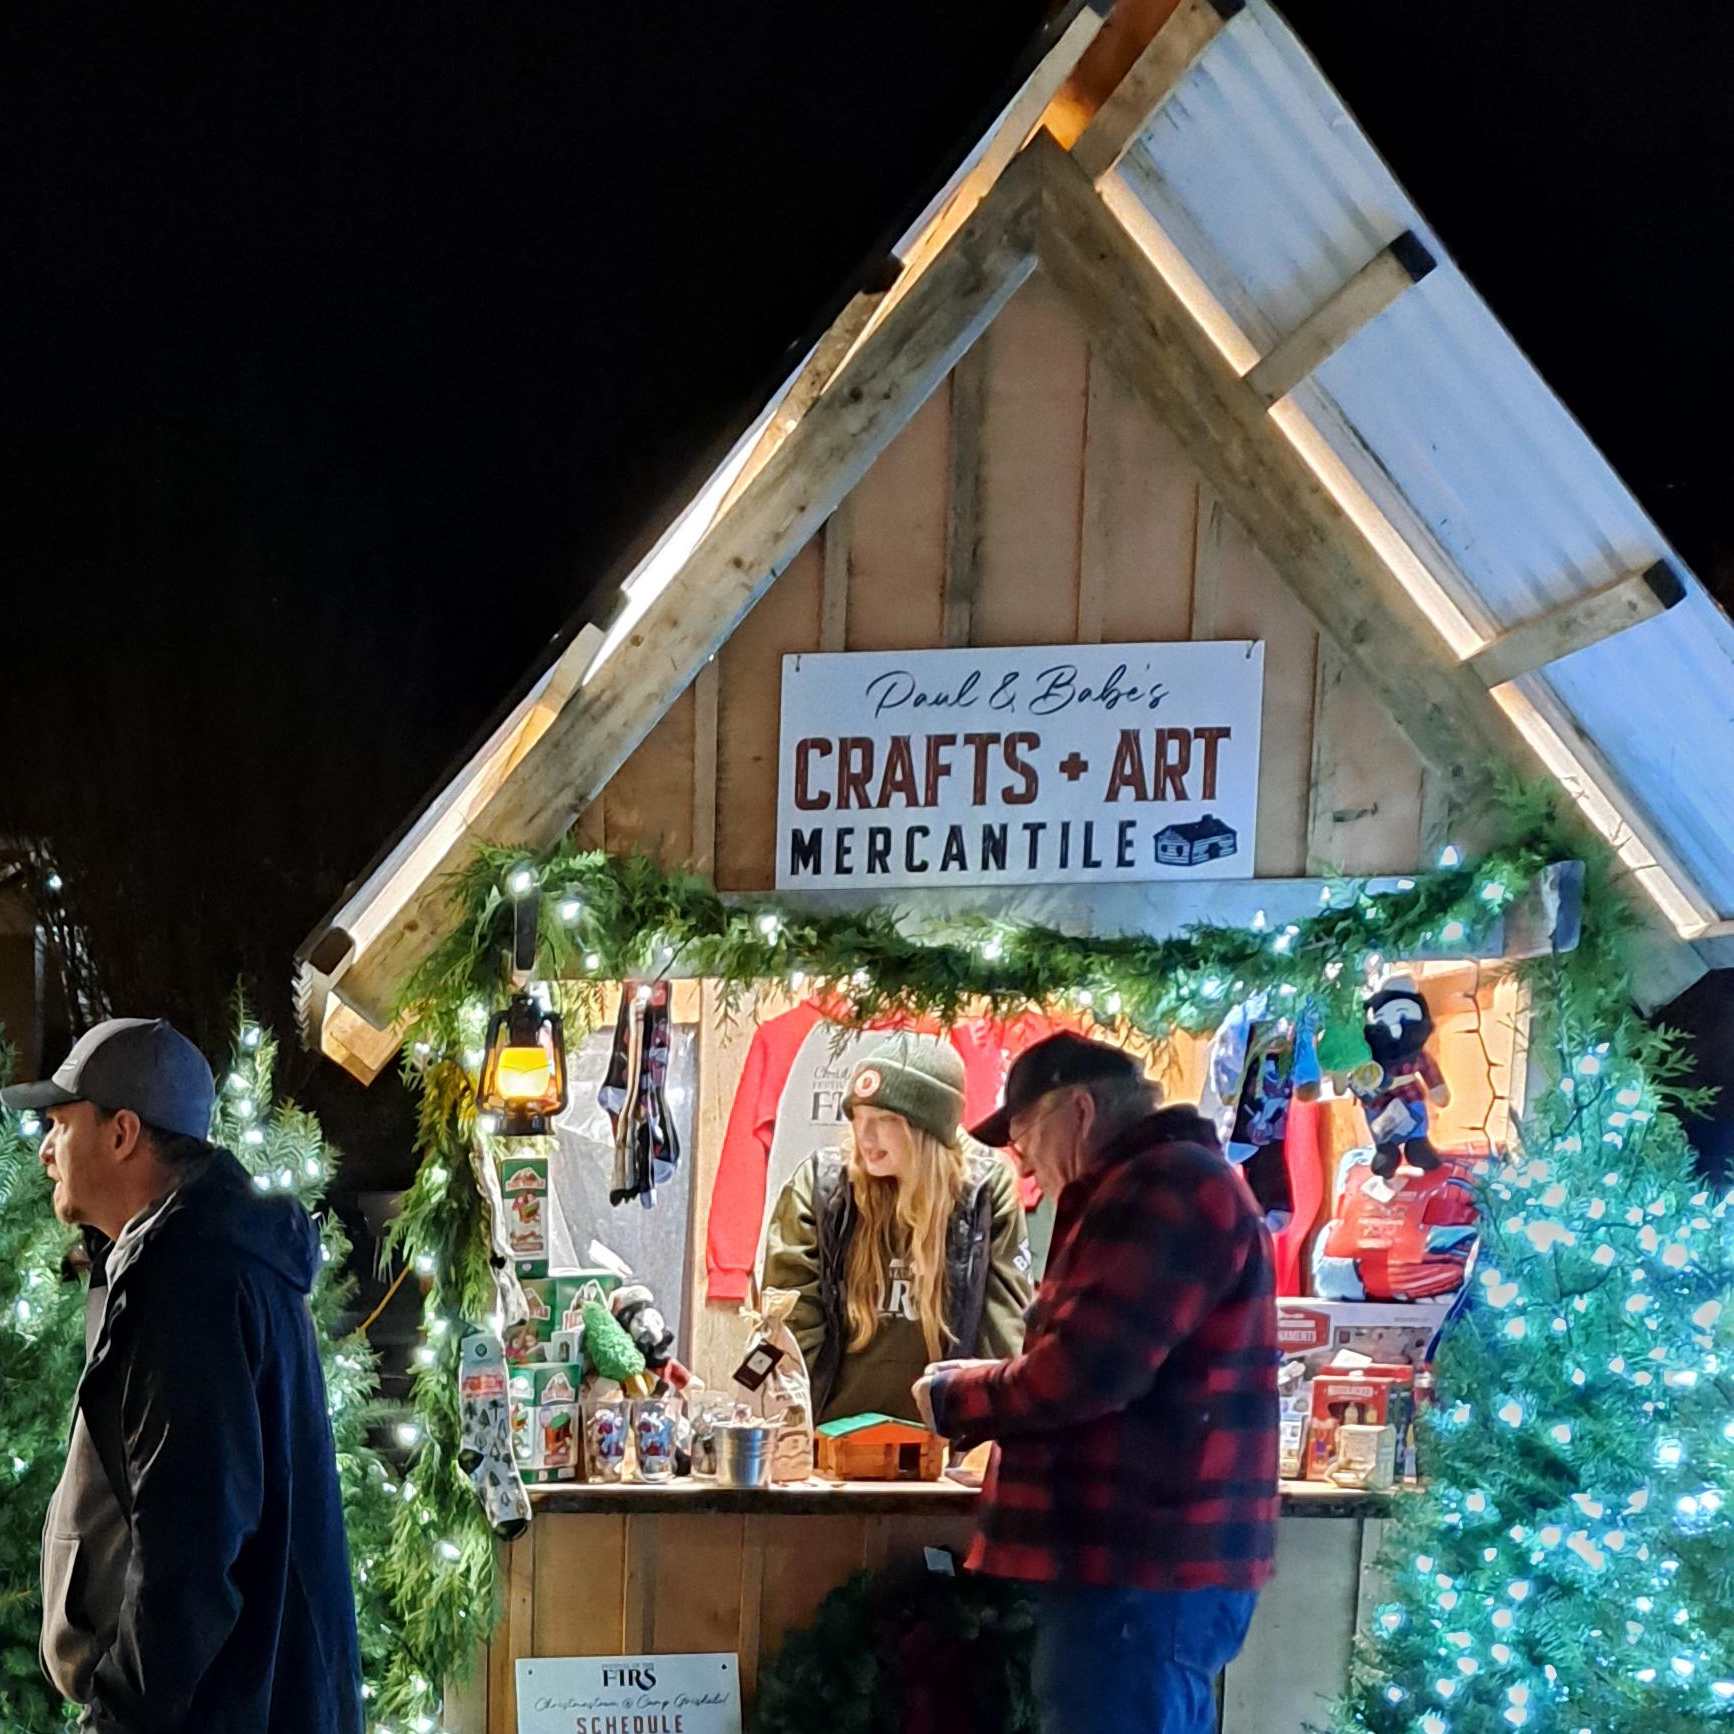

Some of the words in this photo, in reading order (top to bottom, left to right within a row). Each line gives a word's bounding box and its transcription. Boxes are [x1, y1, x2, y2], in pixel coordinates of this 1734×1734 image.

[866, 670, 980, 718] Paul
[989, 671, 1020, 713] &
[1029, 663, 1170, 715] Babe's
[793, 730, 1041, 811] CRAFTS
[1103, 726, 1232, 802] ART
[789, 819, 1137, 876] MERCANTILE
[603, 1669, 657, 1691] FIRS
